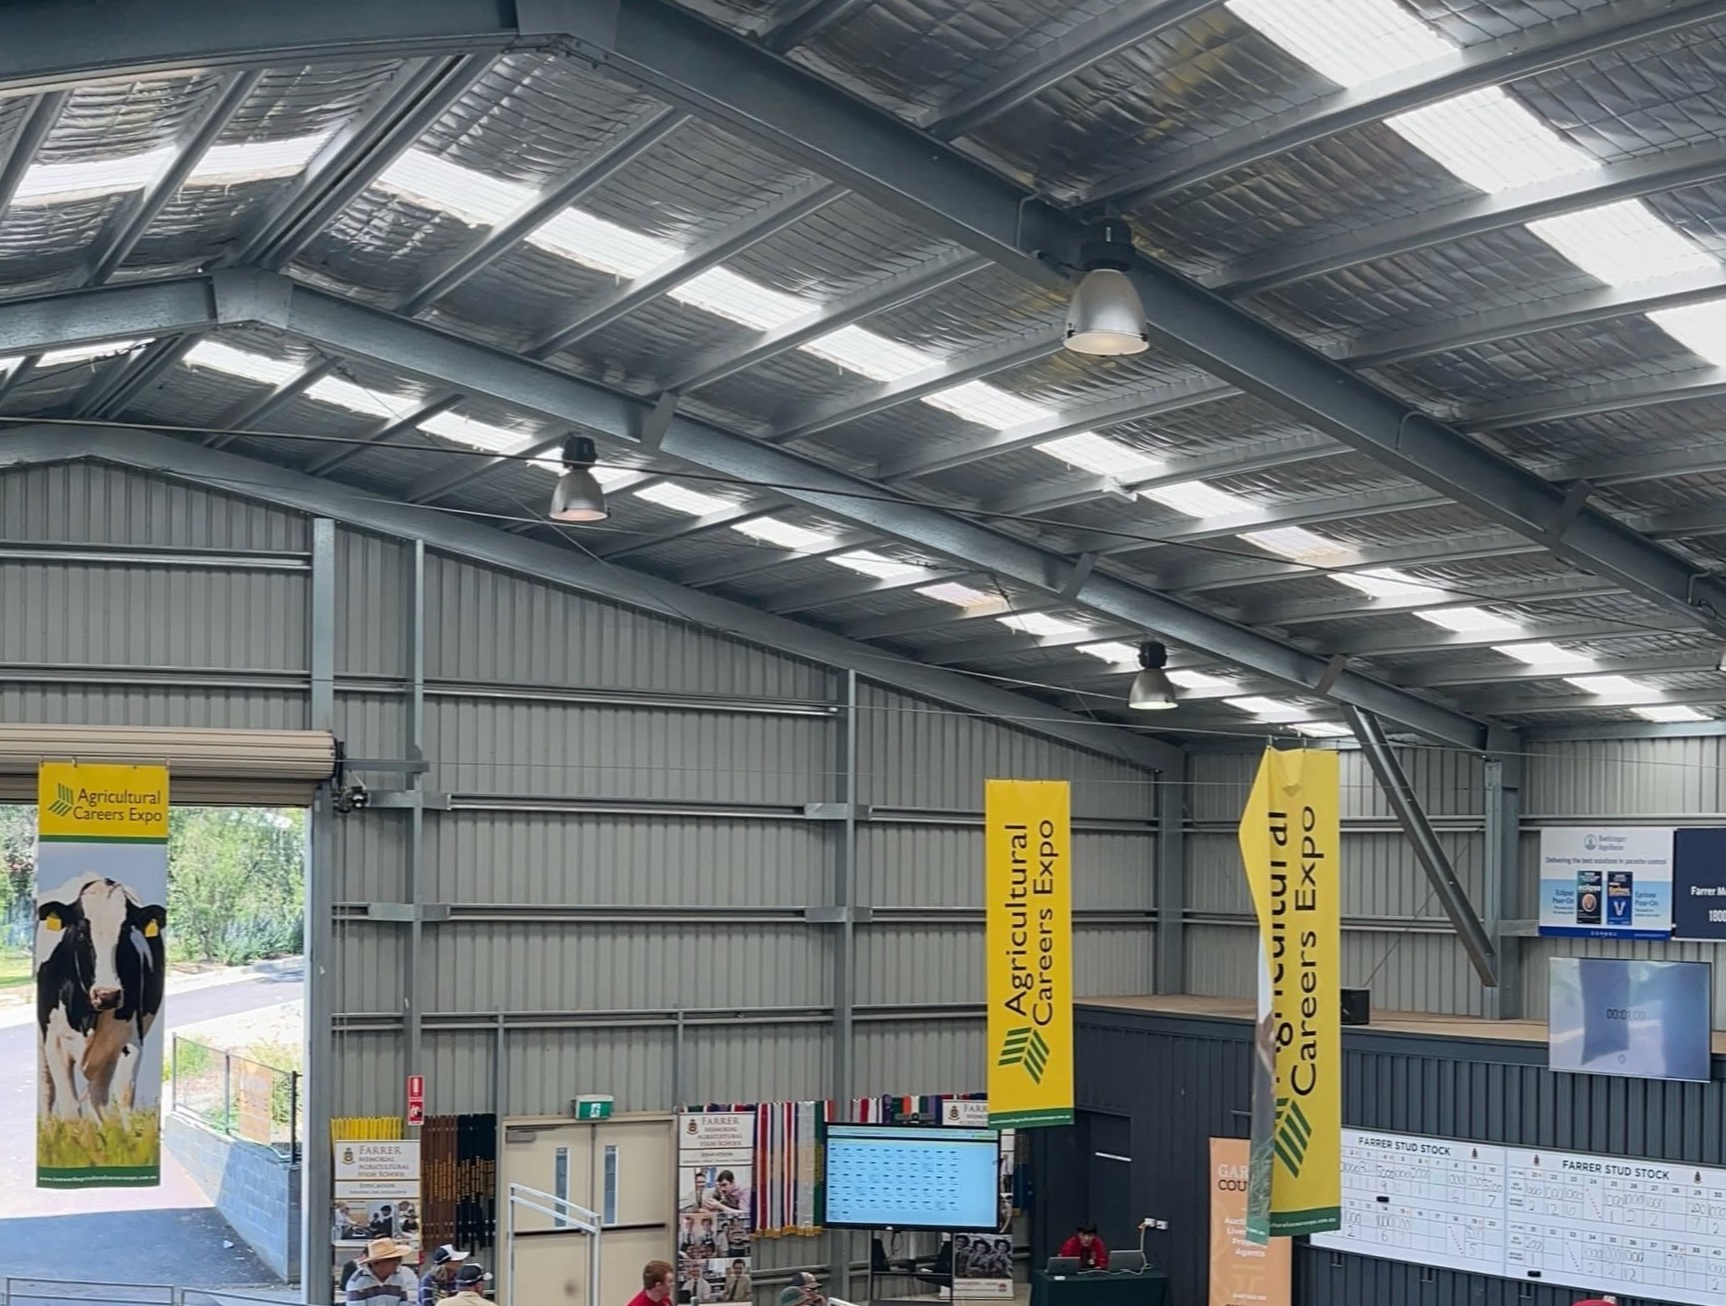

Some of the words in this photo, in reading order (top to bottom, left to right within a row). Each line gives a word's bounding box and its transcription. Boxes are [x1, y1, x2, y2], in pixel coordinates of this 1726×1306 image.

[77, 788, 161, 807] Agricultural
[73, 806, 124, 821] Careers
[129, 807, 162, 825] Expo
[1033, 820, 1059, 895] Expo
[1295, 805, 1325, 912] Expo
[1005, 824, 1034, 1016] Agricultural
[1032, 908, 1053, 1026] Careers
[1291, 929, 1317, 1096] Careers
[964, 1103, 988, 1113] FARR
[702, 1116, 741, 1125] FARRER
[359, 1145, 402, 1155] FARRER
[1358, 1136, 1393, 1149] FARRER
[1395, 1141, 1418, 1152] STUD
[1420, 1144, 1451, 1156] STOCK
[1562, 1160, 1602, 1173] FARRER
[1604, 1164, 1631, 1176] STUD
[1635, 1168, 1670, 1180] STOCK
